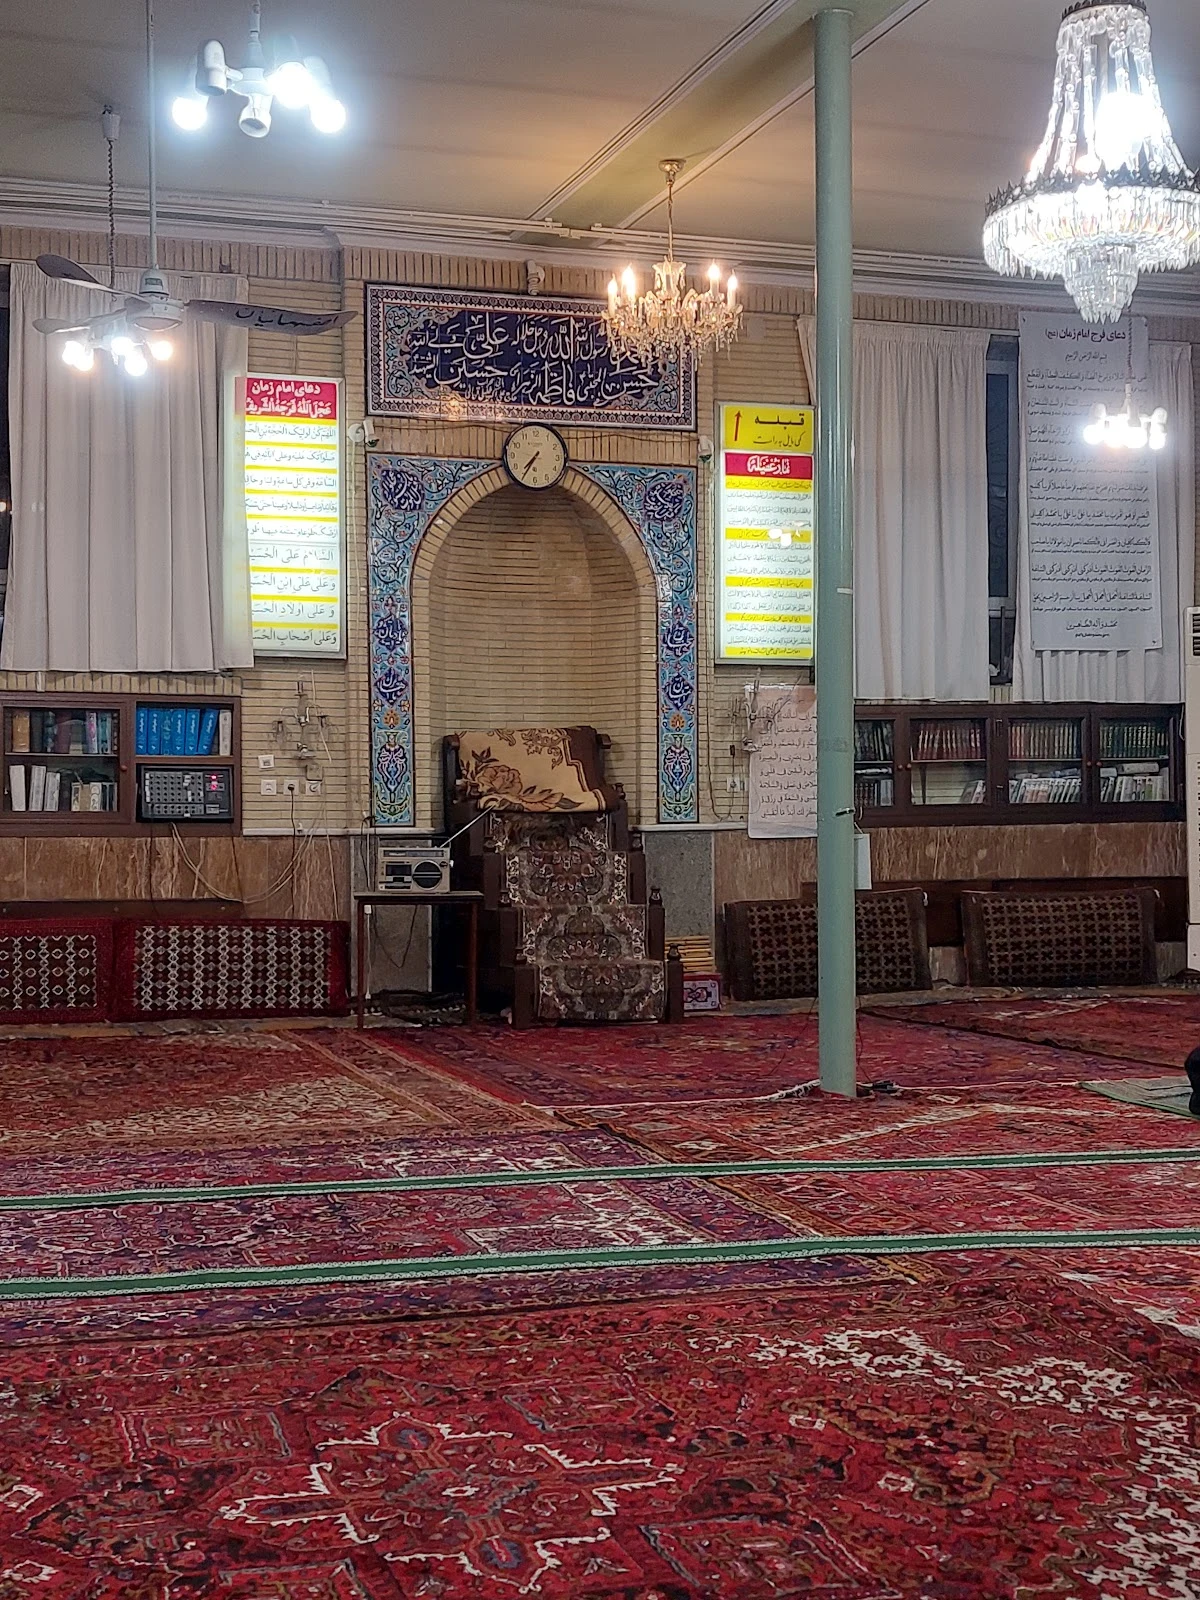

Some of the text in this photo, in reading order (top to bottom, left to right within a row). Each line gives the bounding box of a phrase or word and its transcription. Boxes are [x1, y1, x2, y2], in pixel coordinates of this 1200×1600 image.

[1059, 328, 1076, 340] زمان
[1076, 328, 1090, 341] امام
[1091, 330, 1106, 342] فرج
[1106, 329, 1126, 341] دعای
[252, 380, 321, 399] دعای امام زمان
[754, 412, 805, 431] قبله
[249, 546, 278, 560] الحسی
